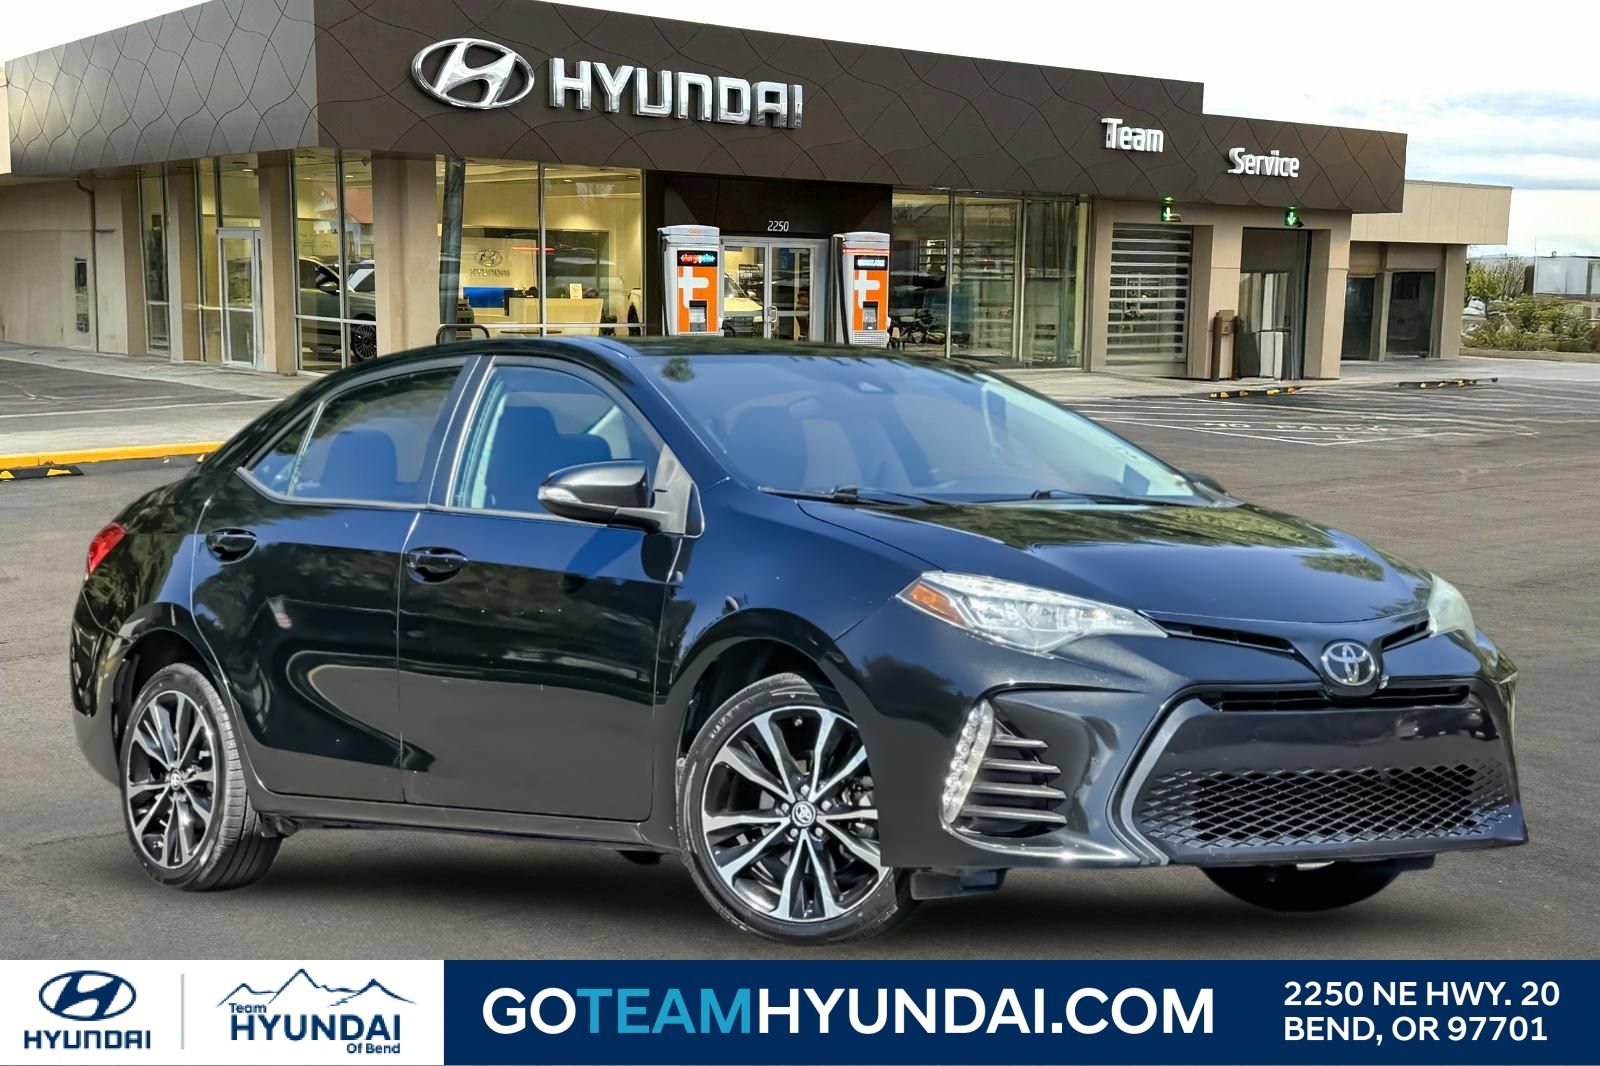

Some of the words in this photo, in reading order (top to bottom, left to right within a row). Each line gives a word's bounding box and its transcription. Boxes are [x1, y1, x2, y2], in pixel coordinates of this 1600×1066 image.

[549, 57, 803, 129] HYUNDAI
[1101, 117, 1164, 153] Team
[1227, 147, 1300, 178] Service
[767, 220, 790, 232] 2250
